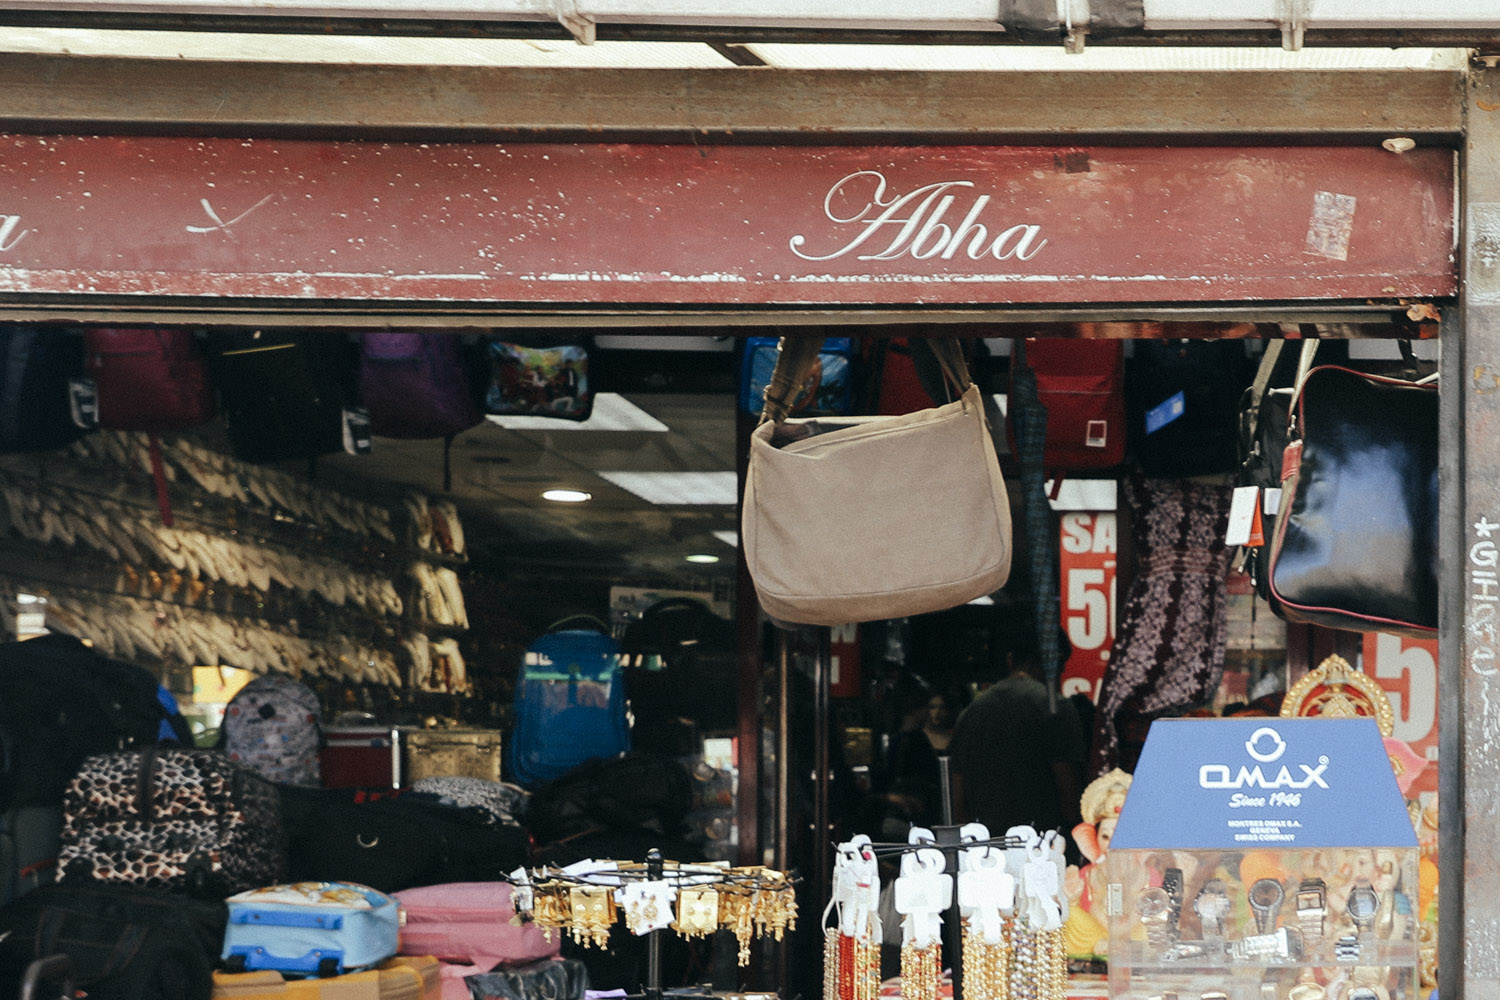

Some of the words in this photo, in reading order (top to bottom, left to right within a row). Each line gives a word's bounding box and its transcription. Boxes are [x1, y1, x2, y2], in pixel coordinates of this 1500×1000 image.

[789, 170, 1048, 260] Abha
[1229, 793, 1266, 808] Since
[1268, 792, 1303, 808] 1946
